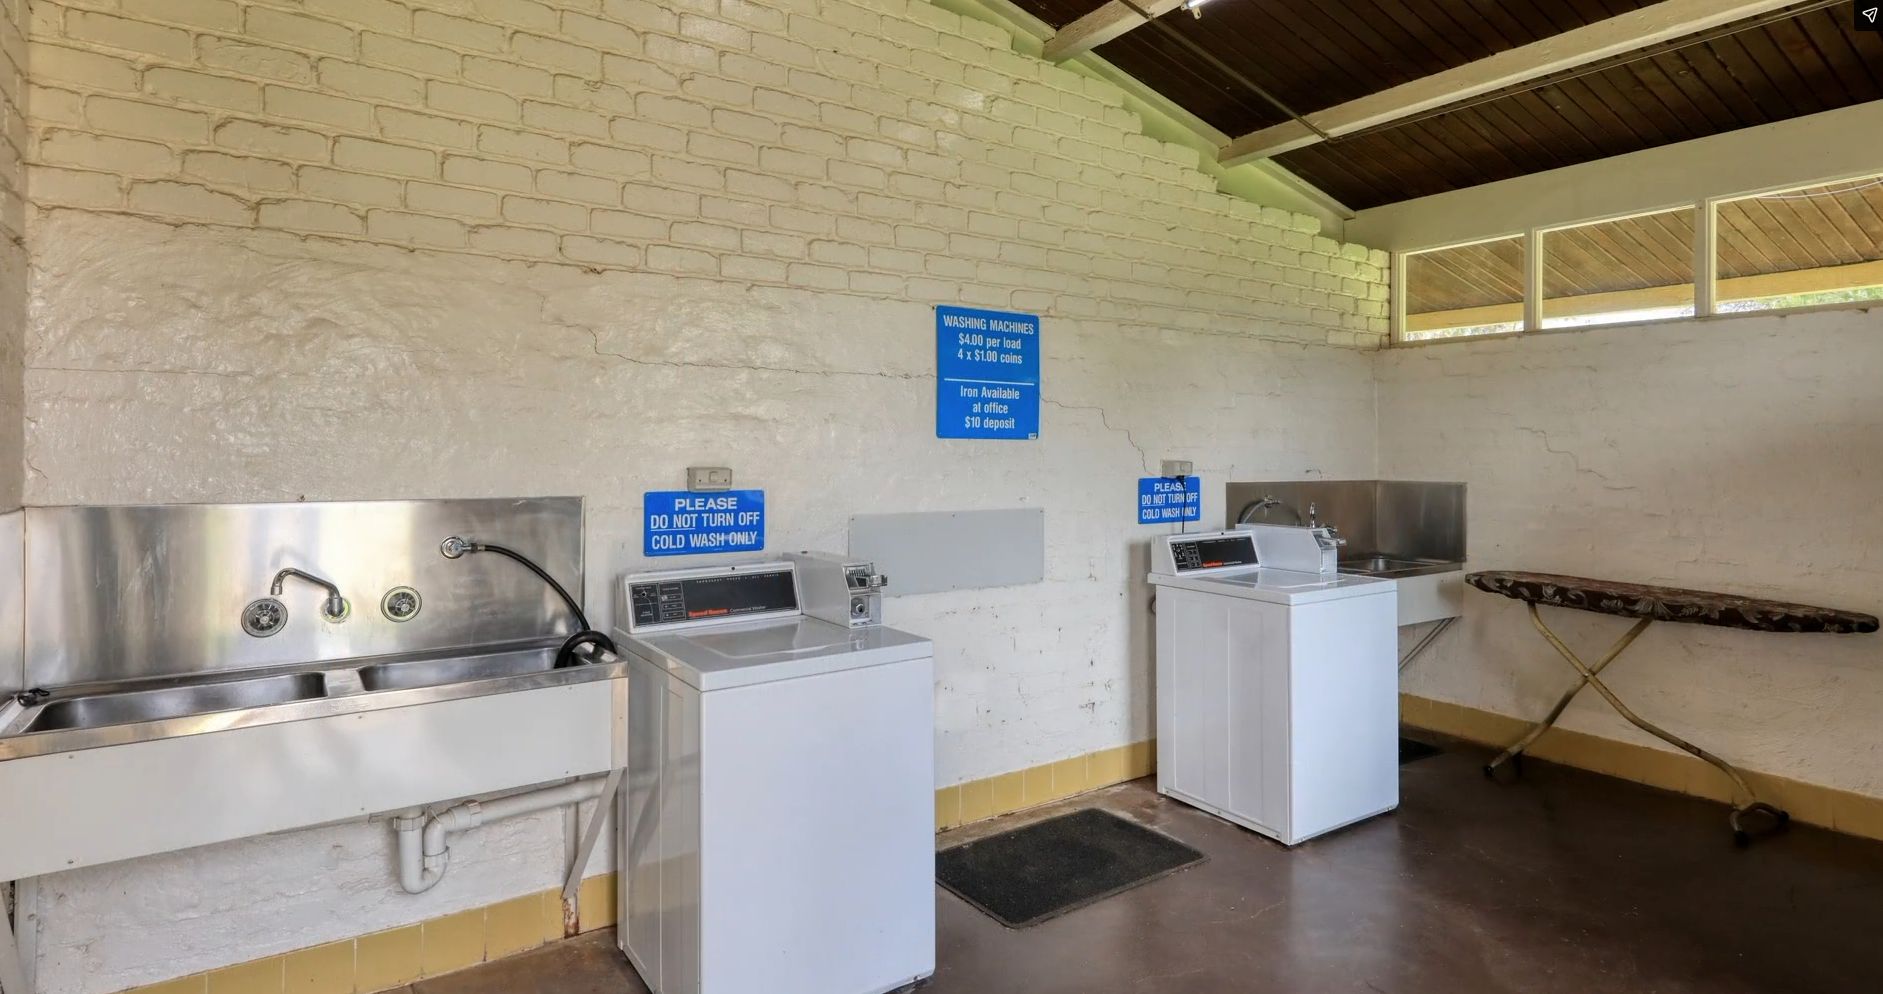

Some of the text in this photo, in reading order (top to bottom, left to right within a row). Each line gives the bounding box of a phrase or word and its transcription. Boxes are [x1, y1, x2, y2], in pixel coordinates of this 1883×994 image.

[943, 314, 1034, 335] WASHING MACHINES
[958, 332, 1022, 349] $4.00 per load
[957, 348, 1023, 364] 4 x $1.00 coins
[960, 385, 1020, 399] Iron Available
[972, 402, 1009, 414] at office
[964, 416, 1015, 431] $10 deposit
[674, 497, 738, 512] PLEASE
[1141, 492, 1198, 505] DO NOT TURN OFF
[650, 511, 760, 529] DO NOT TURN OFF
[1142, 508, 1160, 520] COLD
[1161, 507, 1180, 518] WASH
[651, 531, 758, 550] COLD WASH ONLY
